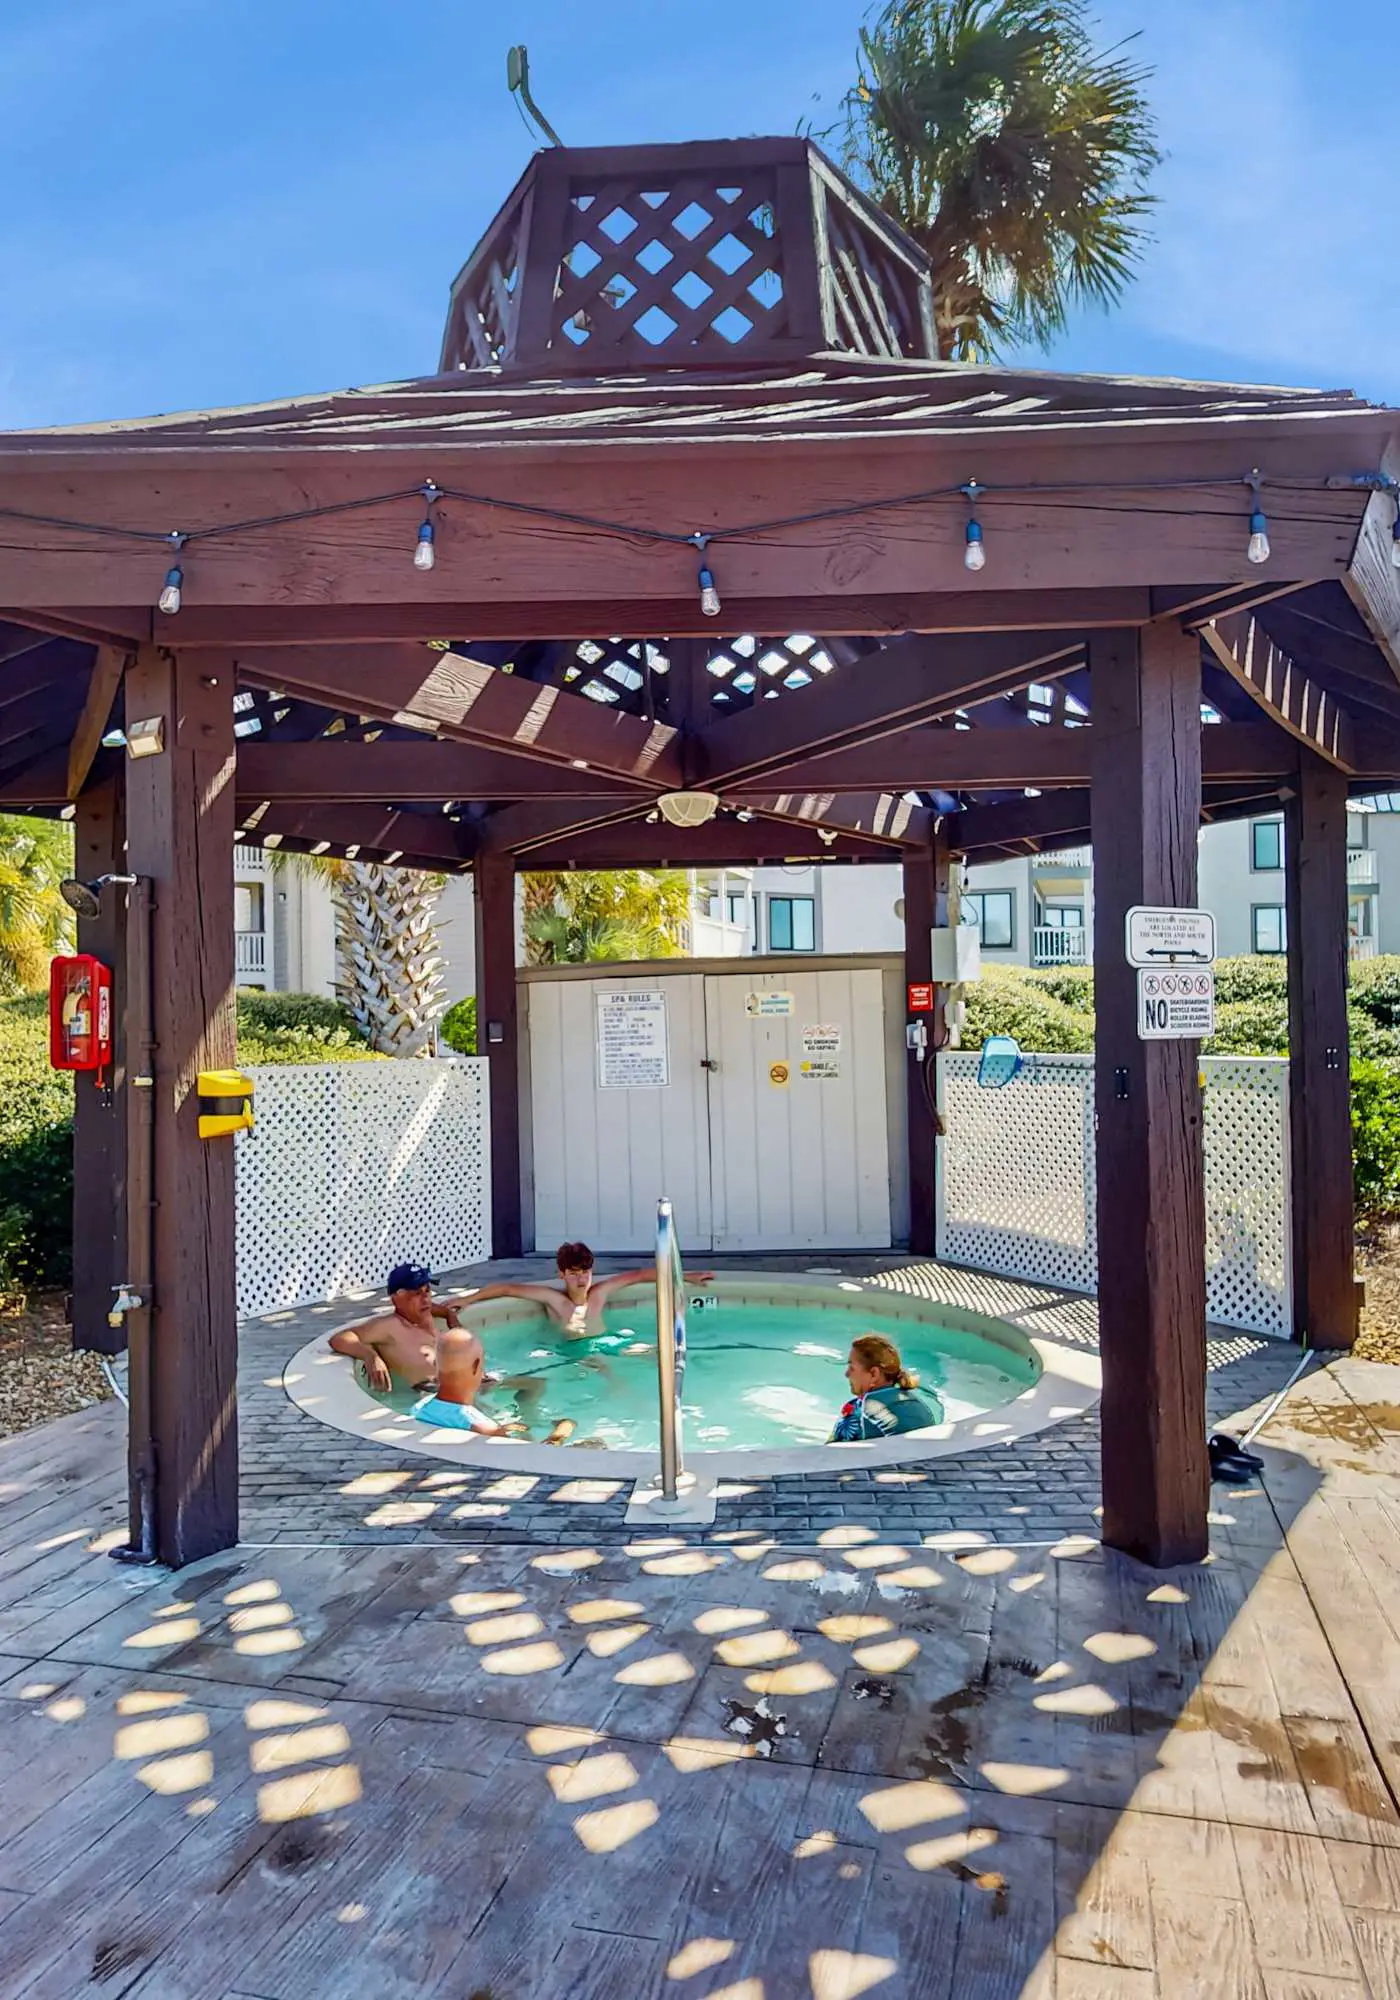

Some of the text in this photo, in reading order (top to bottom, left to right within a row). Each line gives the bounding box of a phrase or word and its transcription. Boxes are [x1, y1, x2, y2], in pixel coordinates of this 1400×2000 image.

[611, 994, 650, 1003] SPA RULES
[1145, 999, 1169, 1030] NO
